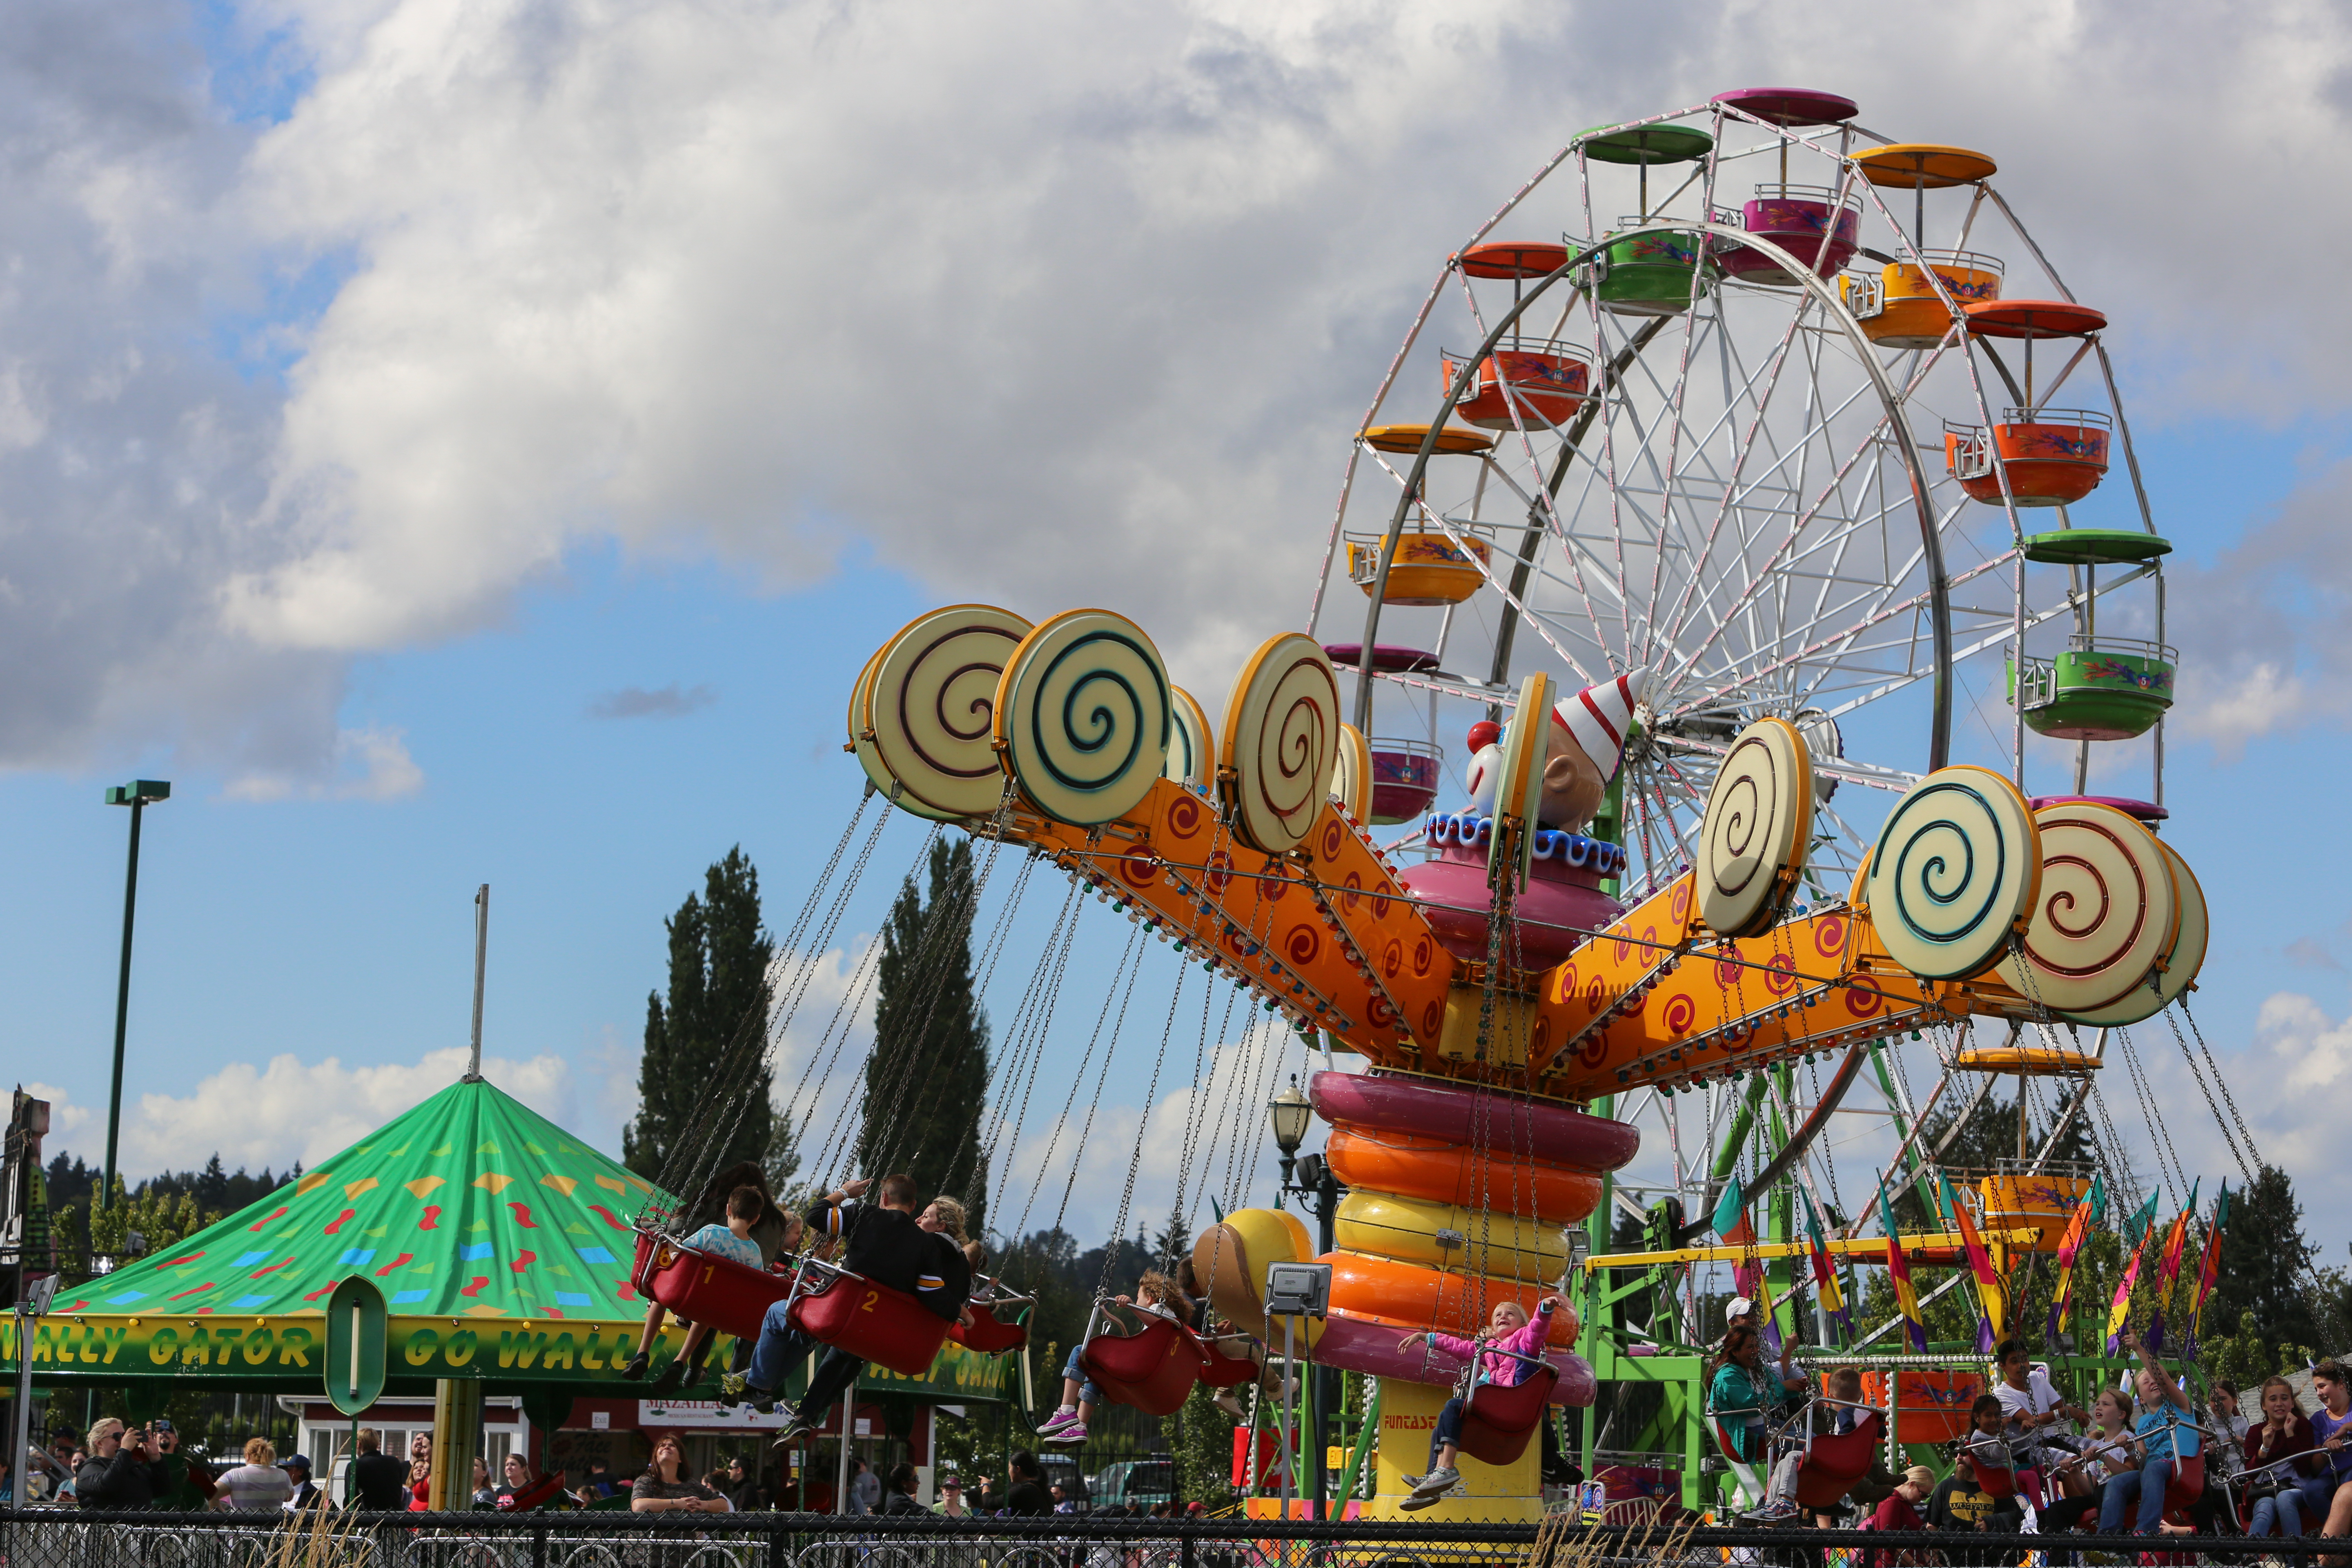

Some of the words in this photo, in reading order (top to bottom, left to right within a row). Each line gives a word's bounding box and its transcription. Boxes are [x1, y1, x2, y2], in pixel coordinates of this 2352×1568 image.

[1965, 287, 1971, 295] 3
[1554, 372, 1563, 381] 16
[2076, 445, 2082, 453] 4
[2140, 677, 2147, 686] 5
[1402, 768, 1411, 778] 14
[704, 1265, 715, 1284] 1
[862, 1291, 878, 1312] 2
[149, 1327, 312, 1368] GATOR
[405, 1328, 477, 1367] GO
[1170, 1336, 1180, 1356] 3
[1947, 1393, 1952, 1402] 8
[575, 1433, 612, 1454] Face
[1655, 1486, 1664, 1495] 10
[1949, 1502, 1994, 1511] WU-TANG
